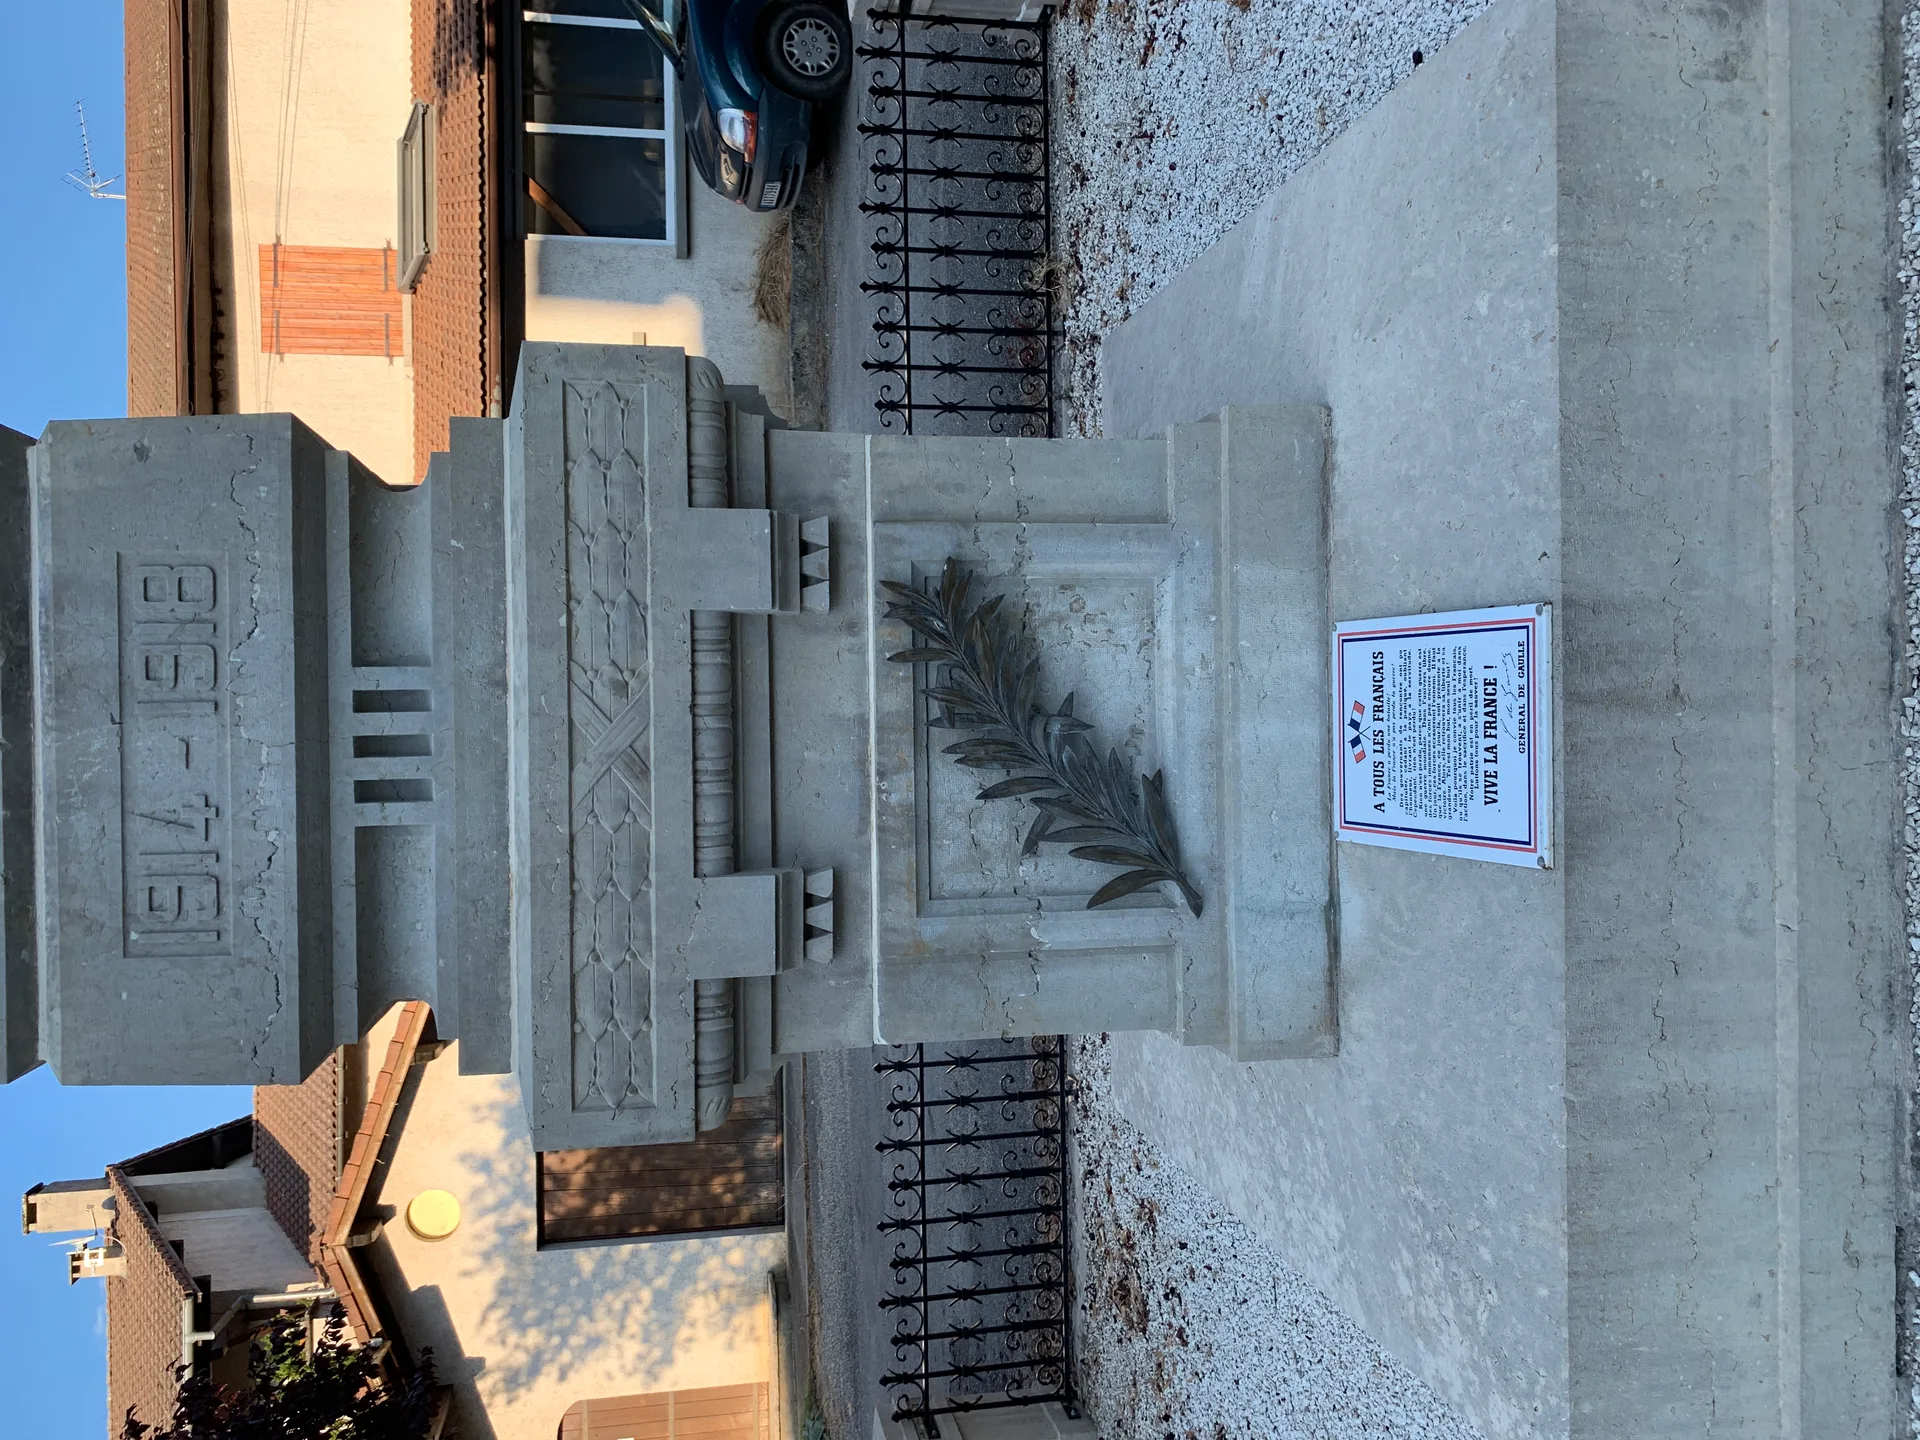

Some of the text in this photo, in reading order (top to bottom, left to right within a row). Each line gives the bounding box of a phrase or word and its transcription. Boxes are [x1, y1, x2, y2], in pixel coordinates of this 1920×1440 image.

[132, 563, 217, 716] 1918
[1483, 678, 1498, 738] FRANCE
[1518, 684, 1525, 698] DE
[1372, 651, 1385, 812] A TOUS LES FRANÇAIS
[1484, 744, 1498, 763] LA
[1484, 770, 1498, 806] VIVE
[136, 795, 219, 943] 1914
